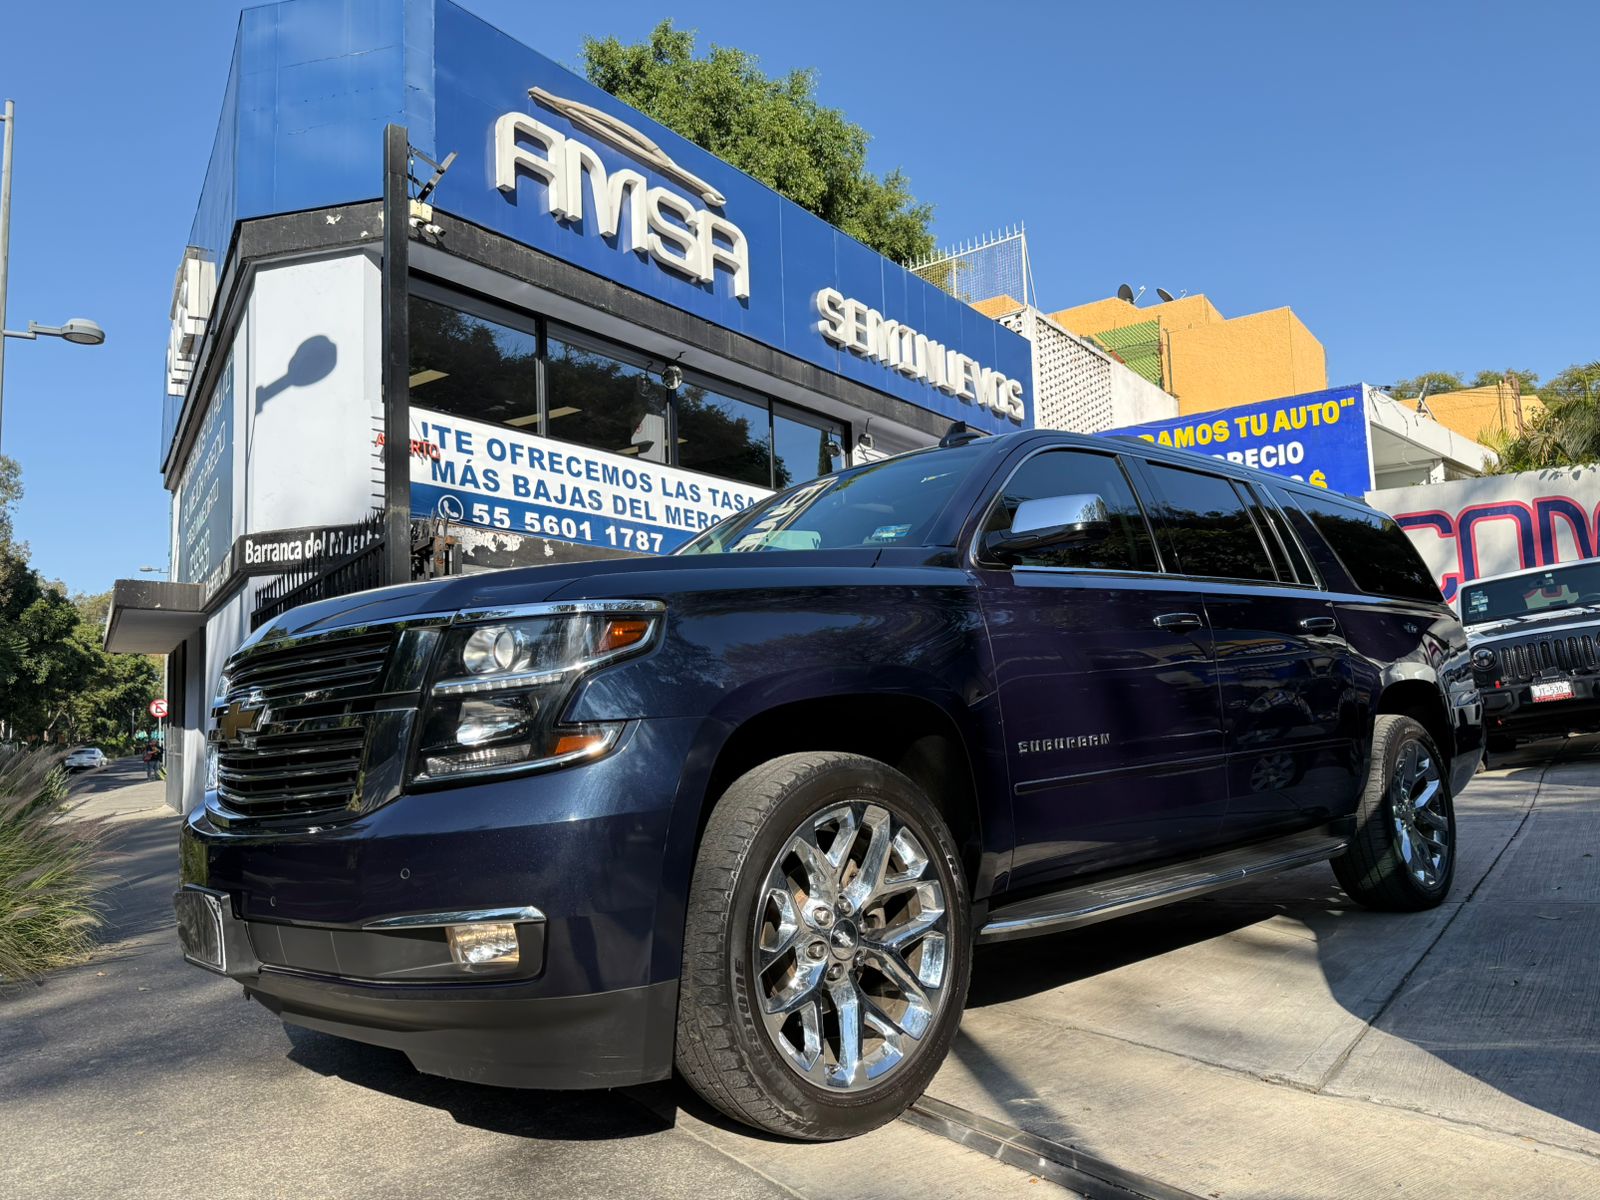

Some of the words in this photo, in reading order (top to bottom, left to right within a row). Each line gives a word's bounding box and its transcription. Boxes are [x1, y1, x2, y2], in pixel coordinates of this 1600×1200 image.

[495, 112, 749, 300] AMSA
[816, 287, 1025, 421] SEMINUEVOS
[1235, 413, 1268, 438] TU
[431, 459, 501, 492] MÁS
[512, 474, 603, 511] BAJAS
[612, 494, 657, 522] DEL
[486, 438, 653, 493] OFRECEMOS
[661, 477, 701, 503] LAS
[245, 539, 302, 564] Barranca
[304, 531, 327, 559] del
[472, 503, 511, 529] 55
[524, 511, 593, 541] 5601
[605, 525, 664, 552] 1787
[1017, 733, 1111, 753] SUBURBAN
